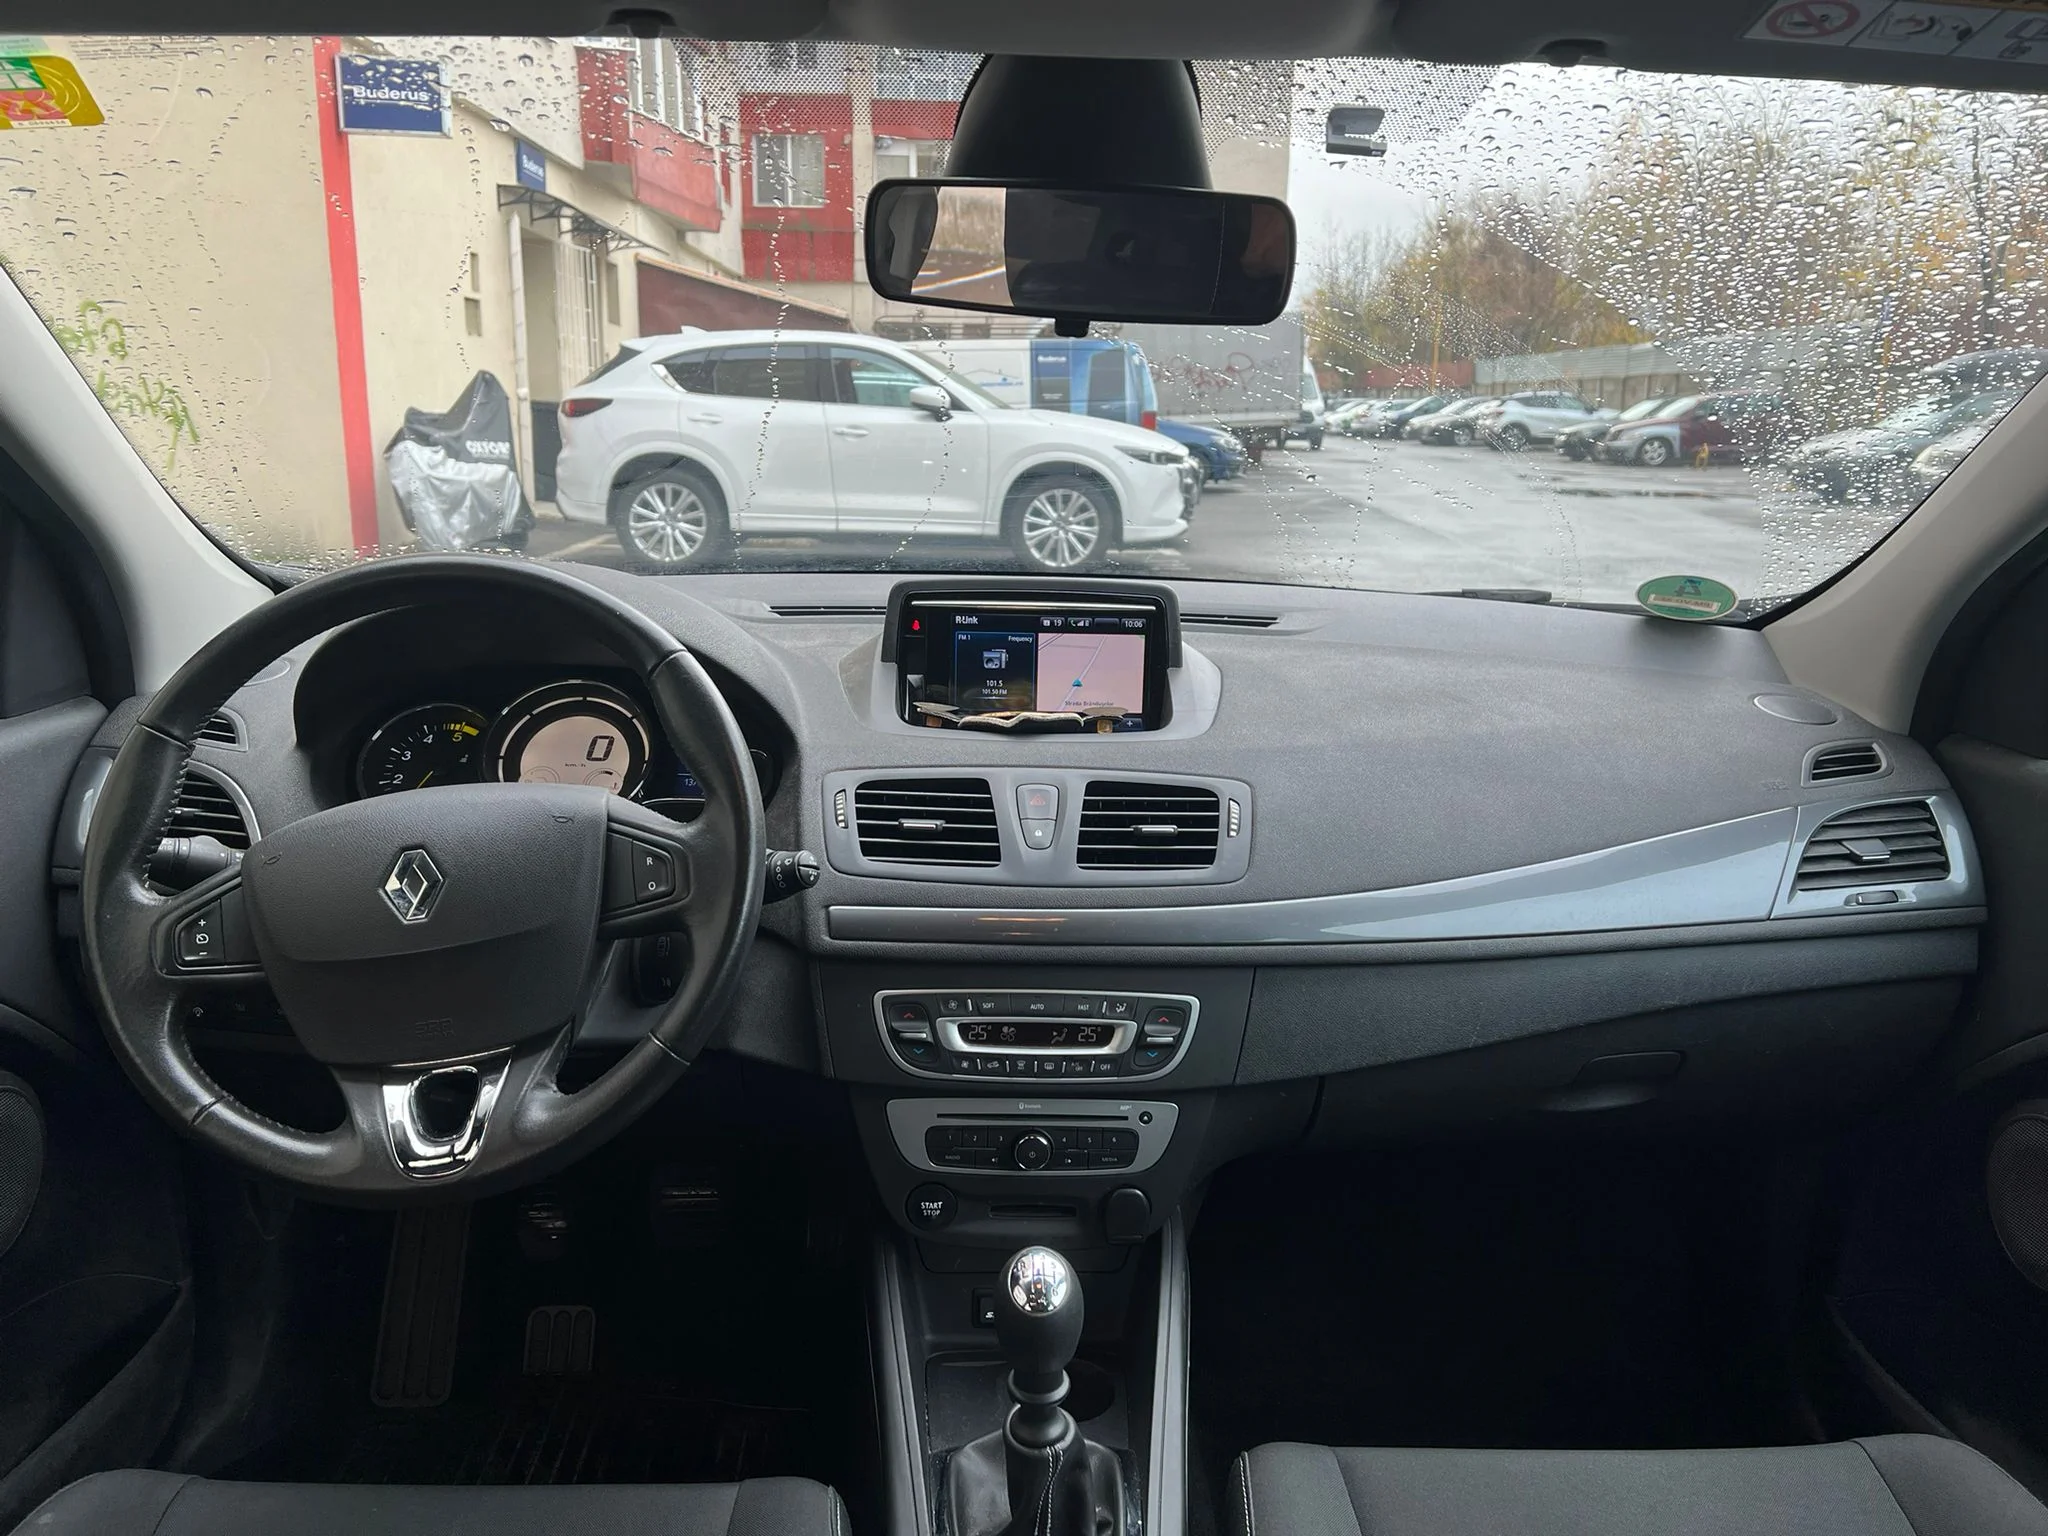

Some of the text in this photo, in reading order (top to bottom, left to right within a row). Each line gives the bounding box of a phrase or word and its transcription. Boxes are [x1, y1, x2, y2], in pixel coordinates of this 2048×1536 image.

[353, 85, 430, 101] Buderus
[1053, 619, 1062, 627] 19
[1125, 620, 1143, 628] 10:06
[1008, 635, 1034, 644] Frequency
[423, 734, 434, 744] 4
[452, 732, 463, 742] 5
[586, 735, 615, 762] 0
[401, 750, 412, 761] 3
[392, 774, 404, 784] 2
[646, 856, 653, 866] R
[1100, 1063, 1111, 1071] OFF
[920, 1201, 943, 1209] START
